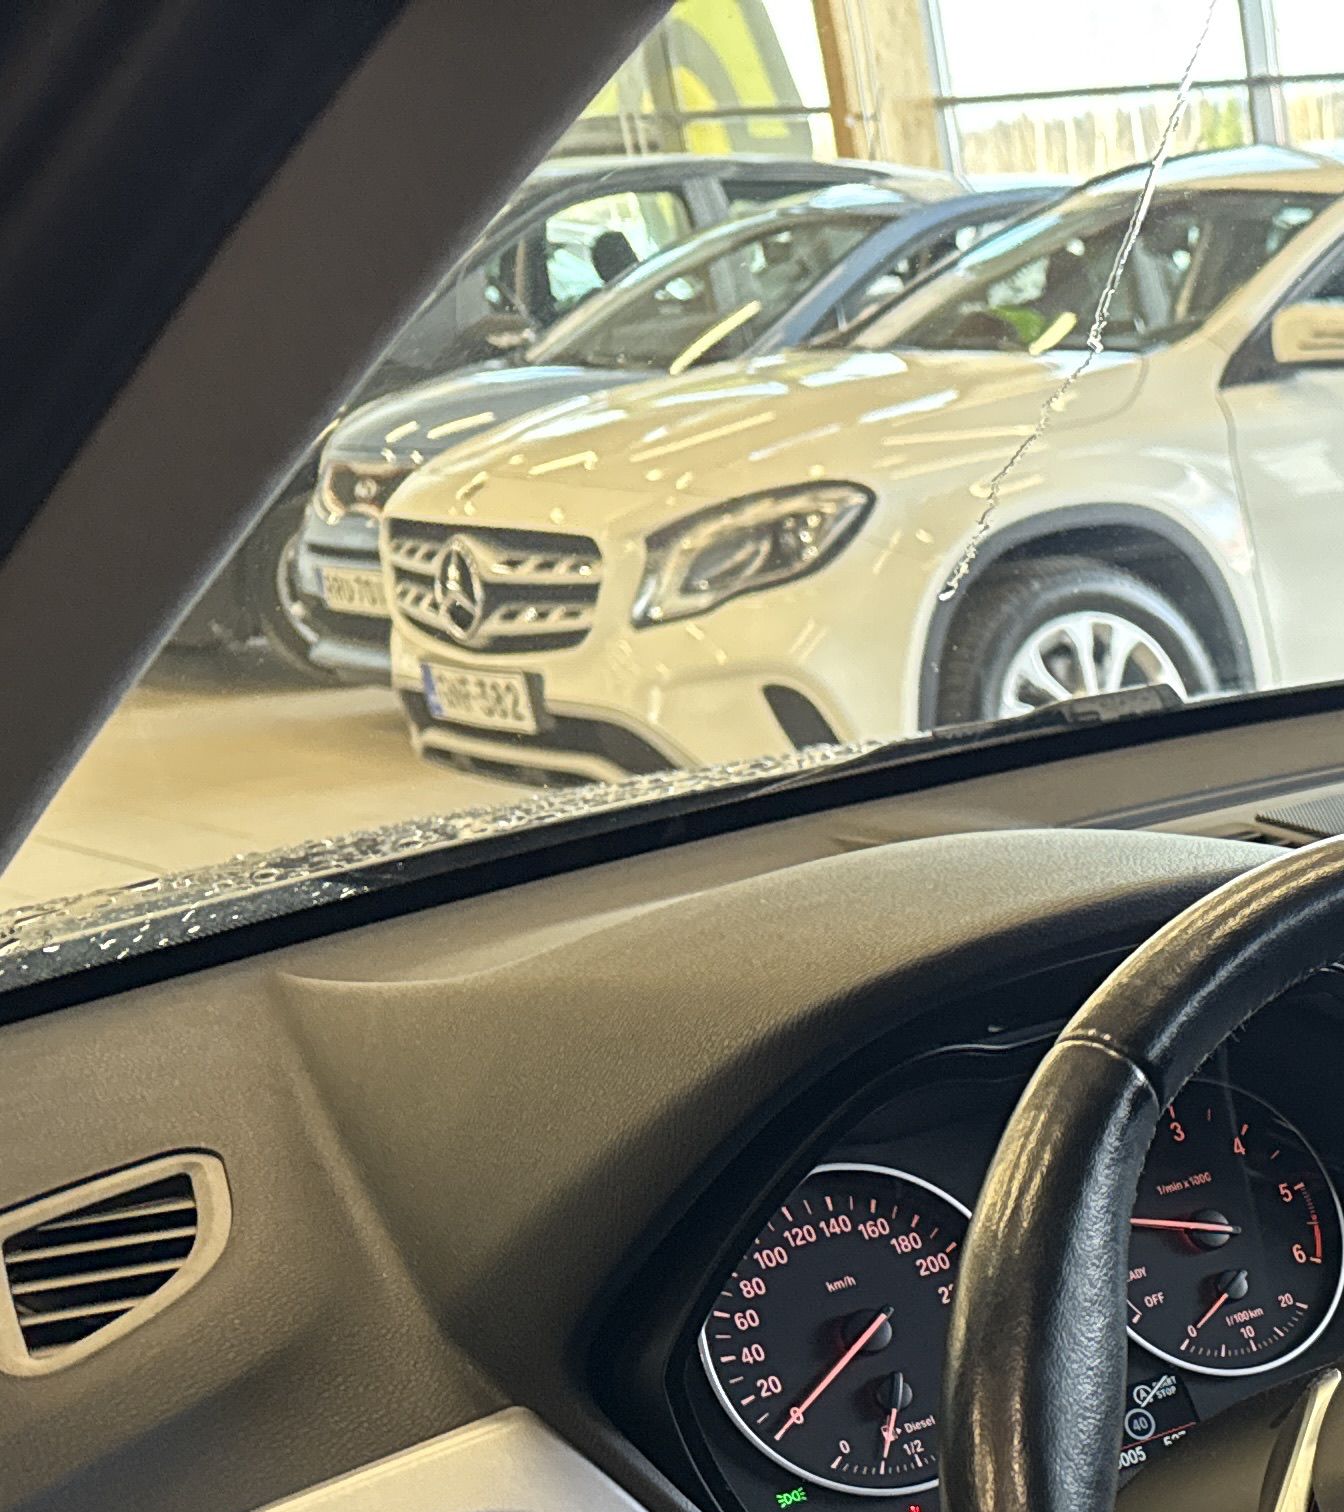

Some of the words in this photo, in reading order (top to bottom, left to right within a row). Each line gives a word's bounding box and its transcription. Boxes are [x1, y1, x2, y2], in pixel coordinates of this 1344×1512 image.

[1170, 1122, 1185, 1141] 3
[1233, 1137, 1246, 1156] 4
[1279, 1183, 1294, 1203] 5
[783, 1224, 818, 1248] 120
[819, 1214, 853, 1239] 140
[858, 1218, 890, 1241] 160
[890, 1231, 923, 1255] 180
[753, 1245, 789, 1270] 100
[1292, 1245, 1308, 1264] 6
[915, 1252, 951, 1277] 200
[739, 1277, 767, 1298] 80
[825, 1275, 857, 1293] km/h
[1144, 1292, 1164, 1307] OFF
[1278, 1293, 1294, 1308] 20
[734, 1308, 761, 1331] 60
[1187, 1325, 1197, 1338] 0
[1240, 1325, 1255, 1339] 10
[741, 1343, 766, 1365] 40
[756, 1374, 783, 1397] 20
[904, 1415, 936, 1434] Diesel
[1133, 1417, 1149, 1431] 40
[838, 1439, 851, 1454] 0
[903, 1439, 925, 1456] 1/2
[1117, 1445, 1147, 1470] 005
